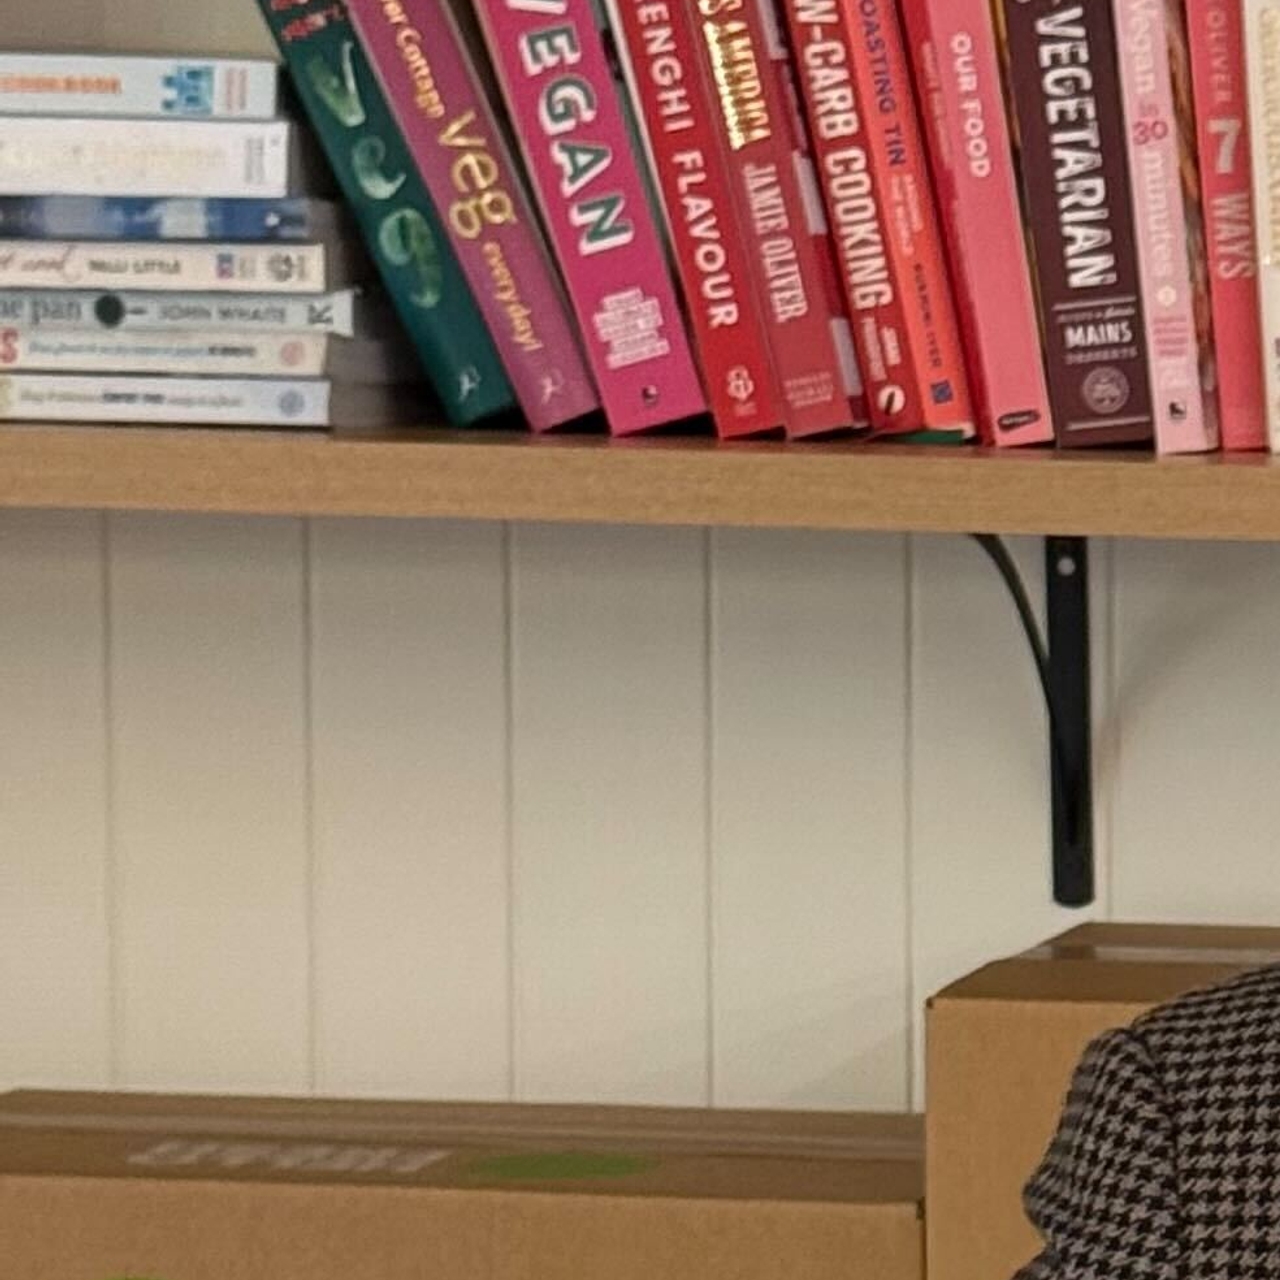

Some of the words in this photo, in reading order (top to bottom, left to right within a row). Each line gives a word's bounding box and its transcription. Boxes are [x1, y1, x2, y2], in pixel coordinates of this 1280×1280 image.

[702, 20, 770, 149] AMERICA
[949, 32, 978, 92] OUR
[1203, 6, 1232, 107] OLIVER
[395, 27, 445, 118] Cottage
[438, 111, 516, 239] veg
[883, 122, 907, 166] TIN
[960, 98, 991, 178] FOOD
[1035, 7, 1115, 287] VEGETARIAN
[1206, 117, 1245, 174] 7
[672, 149, 738, 326] FLAVOUR
[742, 163, 789, 234] JAMIE
[824, 146, 892, 308] COOKING
[1140, 145, 1174, 277] minutes
[1209, 193, 1255, 280] WAYS
[760, 237, 807, 322] OLIVER
[1063, 319, 1133, 348] MAINS
